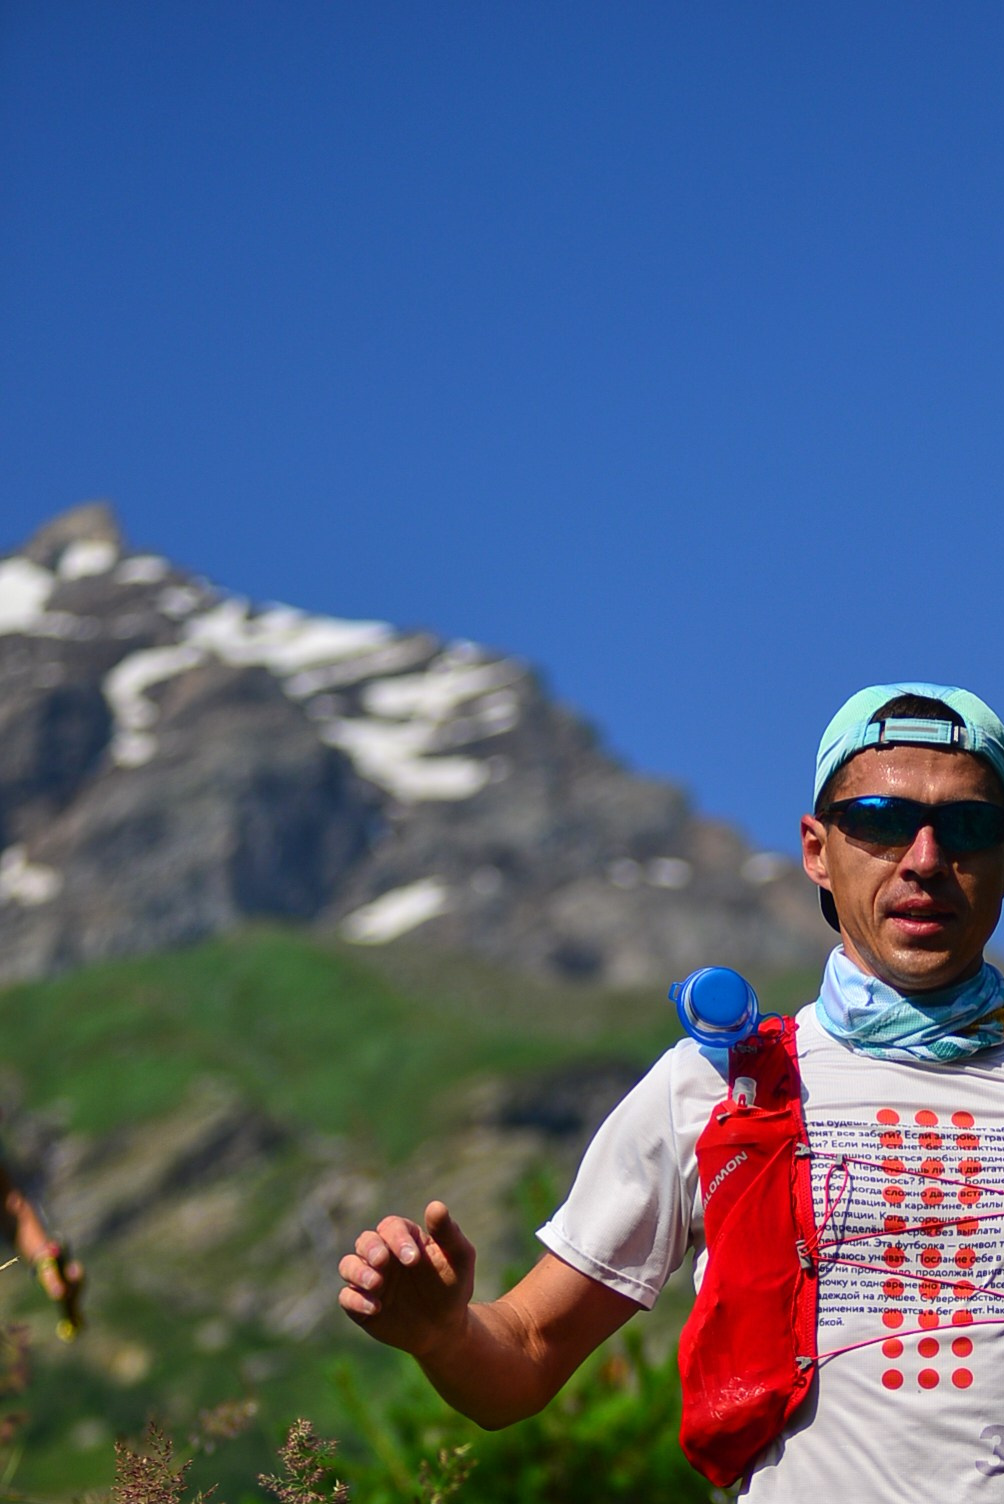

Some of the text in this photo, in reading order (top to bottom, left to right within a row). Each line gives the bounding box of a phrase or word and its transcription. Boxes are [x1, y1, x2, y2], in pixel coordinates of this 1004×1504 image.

[904, 1130, 932, 1140] Если
[934, 1132, 982, 1142] закроют
[831, 1139, 859, 1149] Если
[861, 1141, 884, 1151] мир
[885, 1143, 923, 1151] станет
[874, 1153, 923, 1162] касаться
[925, 1154, 964, 1163] любых
[830, 1174, 915, 1186] осановилось?
[918, 1176, 926, 1186] Я
[885, 1188, 927, 1198] сложно
[929, 1189, 957, 1199] даже
[889, 1201, 903, 1209] на
[904, 1201, 965, 1212] карантине,
[975, 1201, 1003, 1210] силы
[879, 1210, 910, 1223] Когда
[936, 1226, 954, 1237] без
[956, 1226, 1002, 1237] выплаты
[873, 1237, 893, 1249] Эта
[894, 1239, 945, 1252] футболка
[958, 1240, 998, 1250] символ
[915, 1253, 968, 1264] Послание
[969, 1252, 995, 1264] себе
[835, 1265, 849, 1274] ни
[915, 1267, 974, 1278] продолжай
[860, 1279, 938, 1291] одновременно
[862, 1293, 875, 1301] на
[877, 1293, 918, 1304] лучшее.
[920, 1293, 928, 1303] С
[867, 1306, 927, 1318] закончатся,
[935, 1306, 953, 1316] бег
[965, 1307, 986, 1316] нет.
